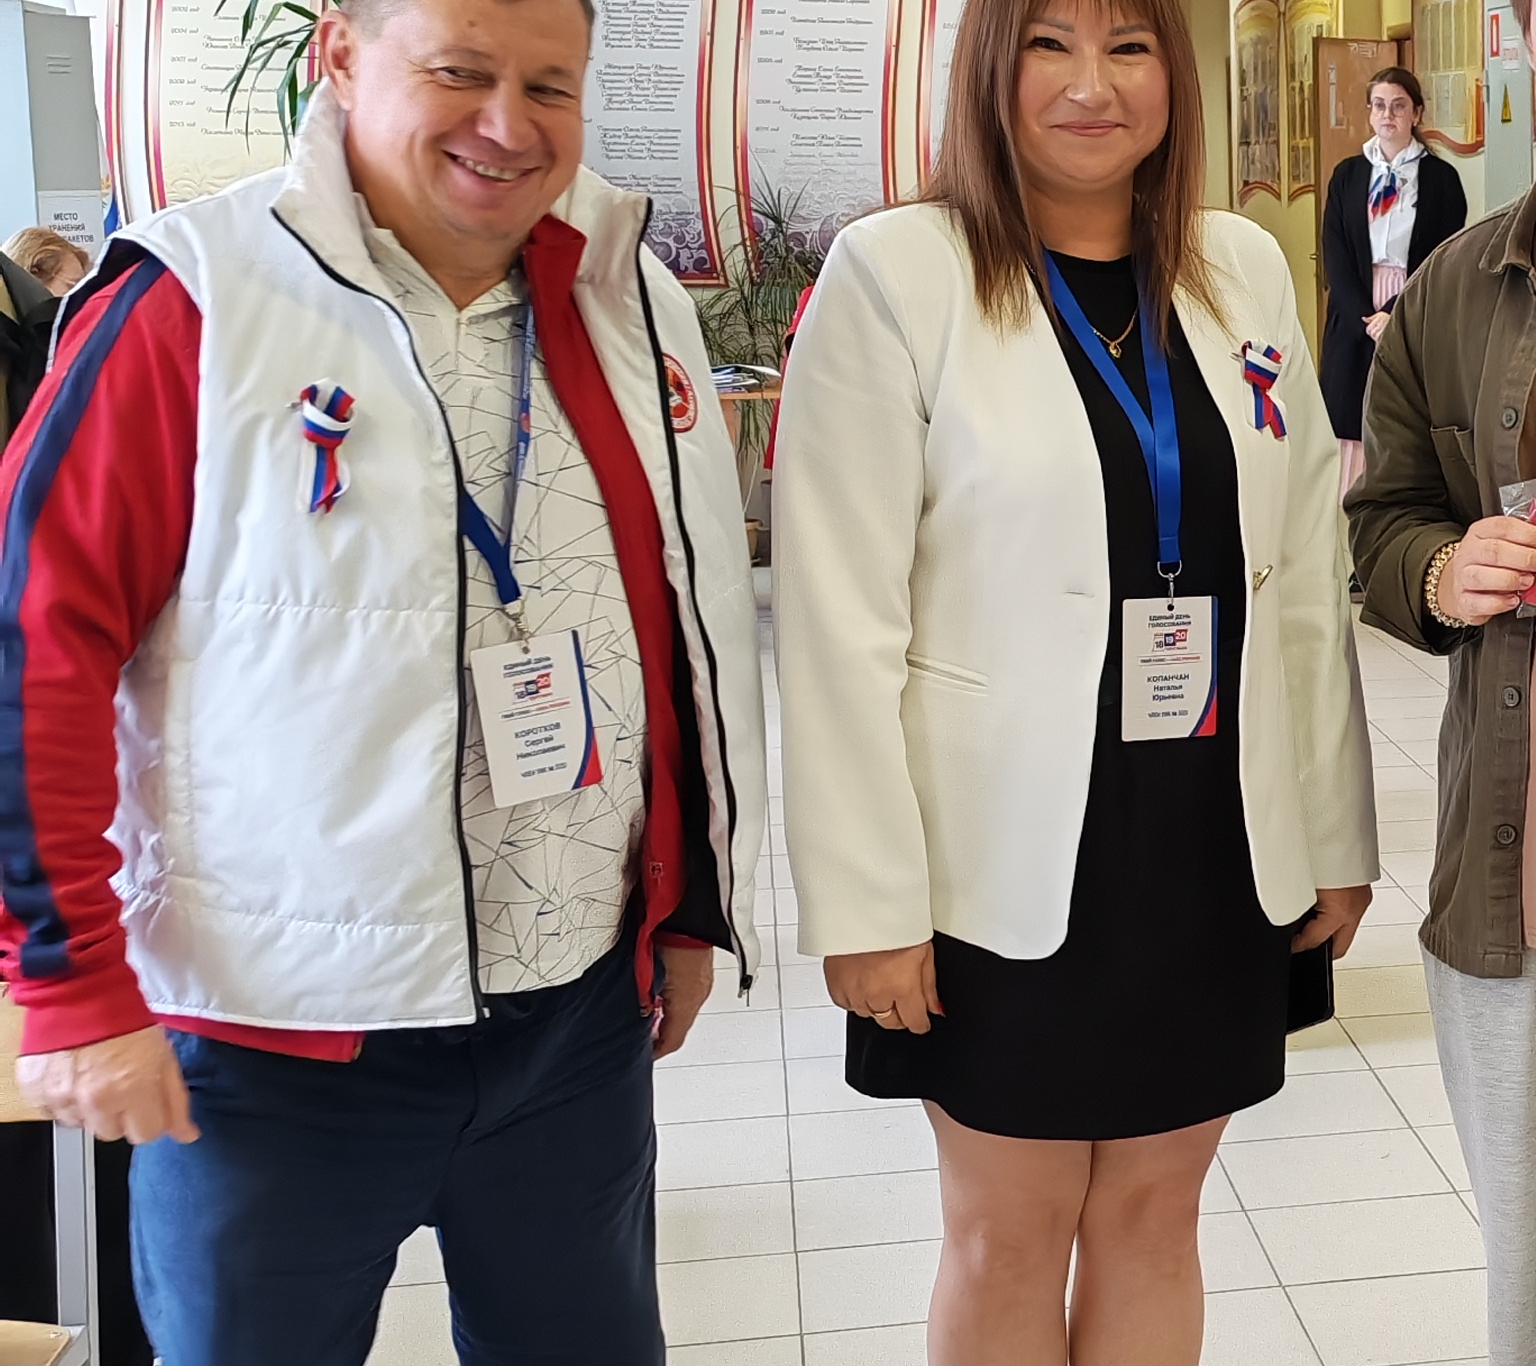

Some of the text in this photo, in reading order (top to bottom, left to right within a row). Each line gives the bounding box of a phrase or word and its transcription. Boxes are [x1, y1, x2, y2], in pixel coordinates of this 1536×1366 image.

[53, 212, 78, 221] МЕСТО
[64, 235, 94, 243] АКЕТОВ
[1176, 631, 1186, 640] 20
[1154, 684, 1183, 692] Наталья
[1152, 693, 1185, 703] Юрьевна
[514, 722, 561, 739] КОРОТКОВ
[524, 735, 554, 747] Сергей
